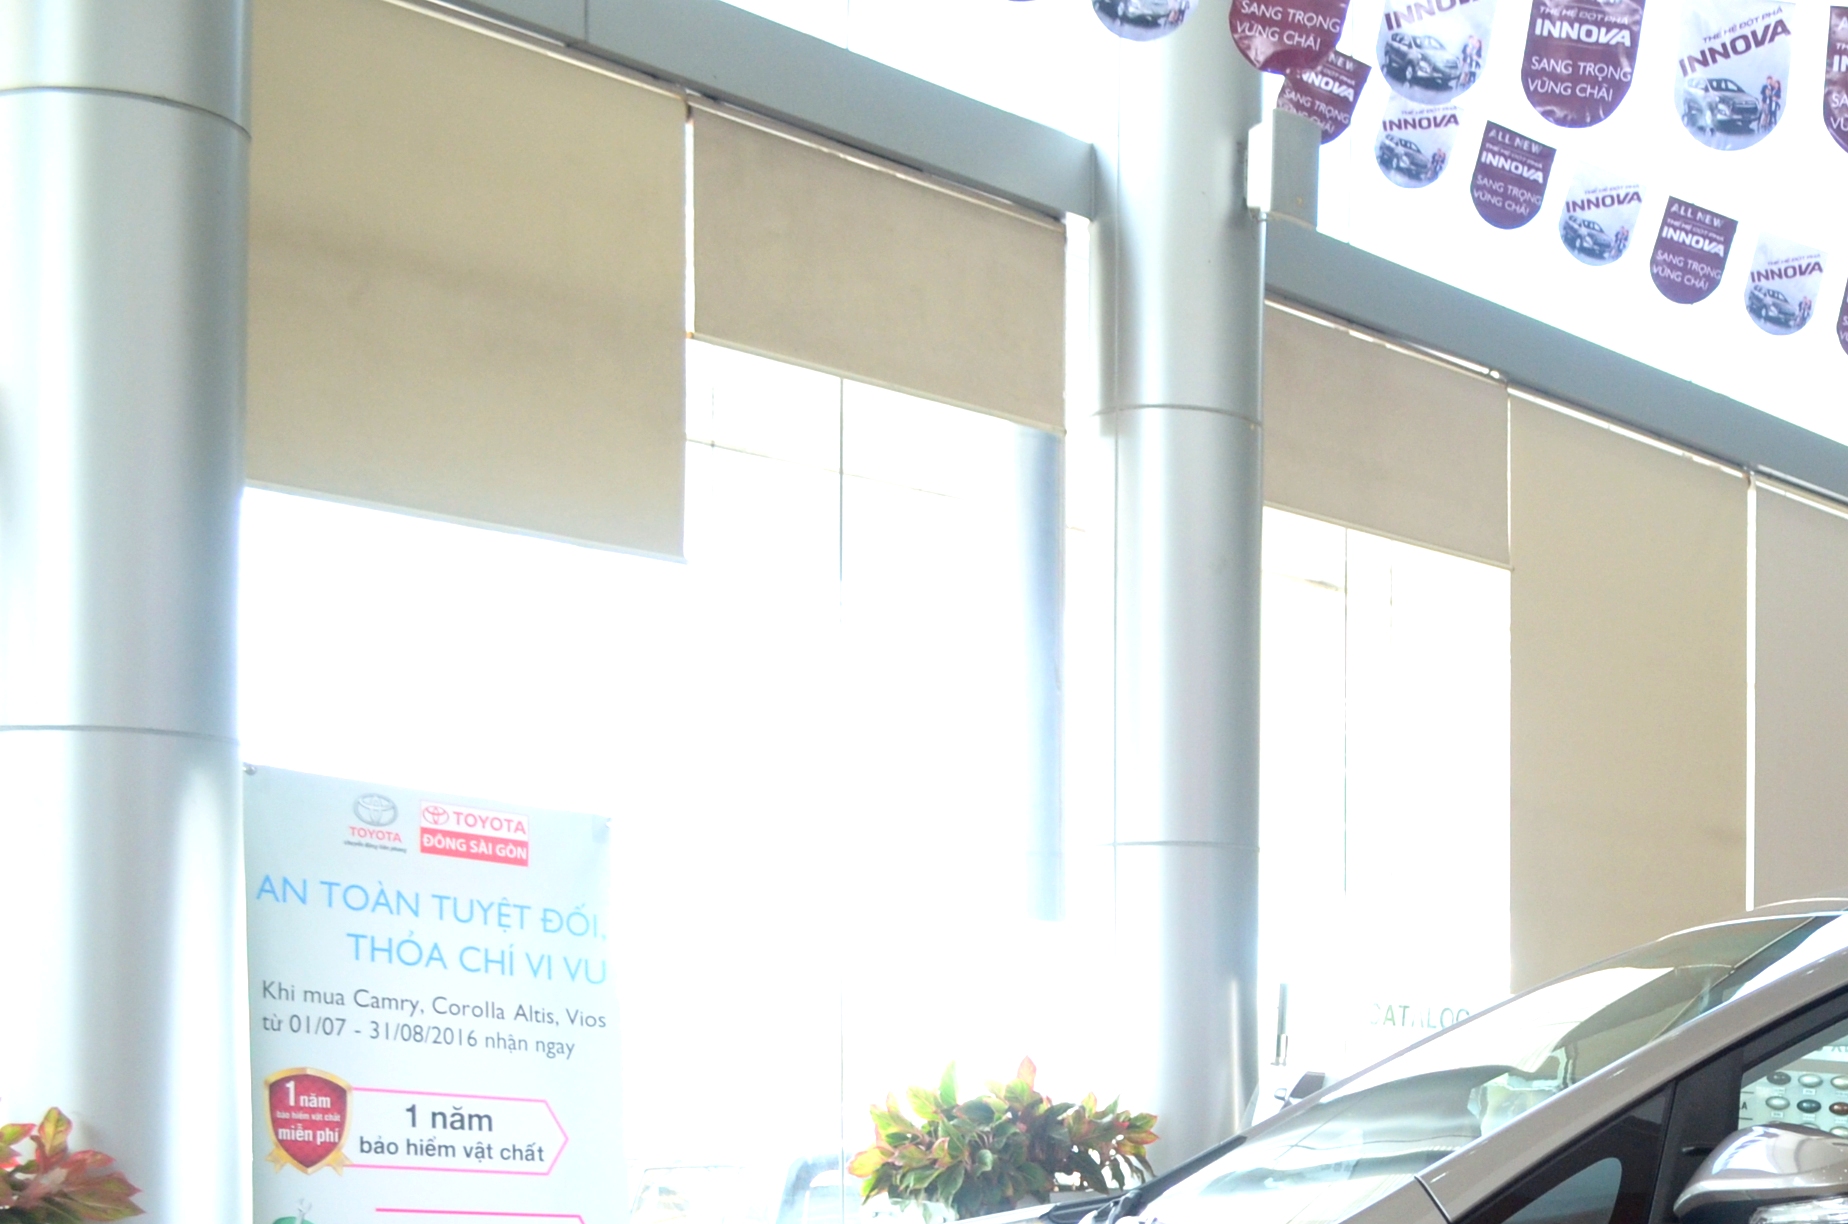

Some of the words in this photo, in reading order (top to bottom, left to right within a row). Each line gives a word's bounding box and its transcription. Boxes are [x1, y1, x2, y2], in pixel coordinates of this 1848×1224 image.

[1241, 0, 1283, 21] SANG
[1287, 10, 1341, 34] TRỌNG
[1535, 18, 1632, 47] INNOVA
[1678, 18, 1792, 78] INNOVA
[1382, 114, 1459, 132] INNOVA
[1750, 261, 1823, 283] INNOVA
[349, 826, 402, 843] TOYOTA
[453, 811, 526, 835] TOYOTA
[423, 834, 467, 851] ĐÔNG
[470, 839, 492, 855] SÀI
[496, 844, 527, 859] GÒN
[256, 874, 307, 906] AN
[320, 880, 419, 918] TOÀN
[431, 893, 530, 933] TUYỆT
[459, 943, 514, 976] CHÍ
[525, 952, 552, 980] VI
[564, 956, 606, 984] VU
[262, 980, 294, 1001] Khi
[303, 988, 345, 1006] mua
[353, 989, 424, 1016] Camry,
[432, 996, 505, 1020] Corolla
[514, 1005, 559, 1026] Altis,
[565, 1009, 606, 1027] Vios
[289, 1015, 346, 1036] 01/07
[369, 1022, 478, 1047] 31/08/2016
[485, 1033, 528, 1052] nhận
[535, 1039, 575, 1059] ngay
[285, 1081, 295, 1106] 1
[300, 1093, 331, 1108] năm
[405, 1104, 417, 1128] 1
[431, 1106, 493, 1133] năm
[278, 1124, 313, 1141] miễn
[317, 1128, 339, 1145] phí
[359, 1135, 399, 1156] bảo
[406, 1137, 456, 1159] hiểm
[463, 1140, 493, 1163] vật
[499, 1141, 545, 1163] chất
